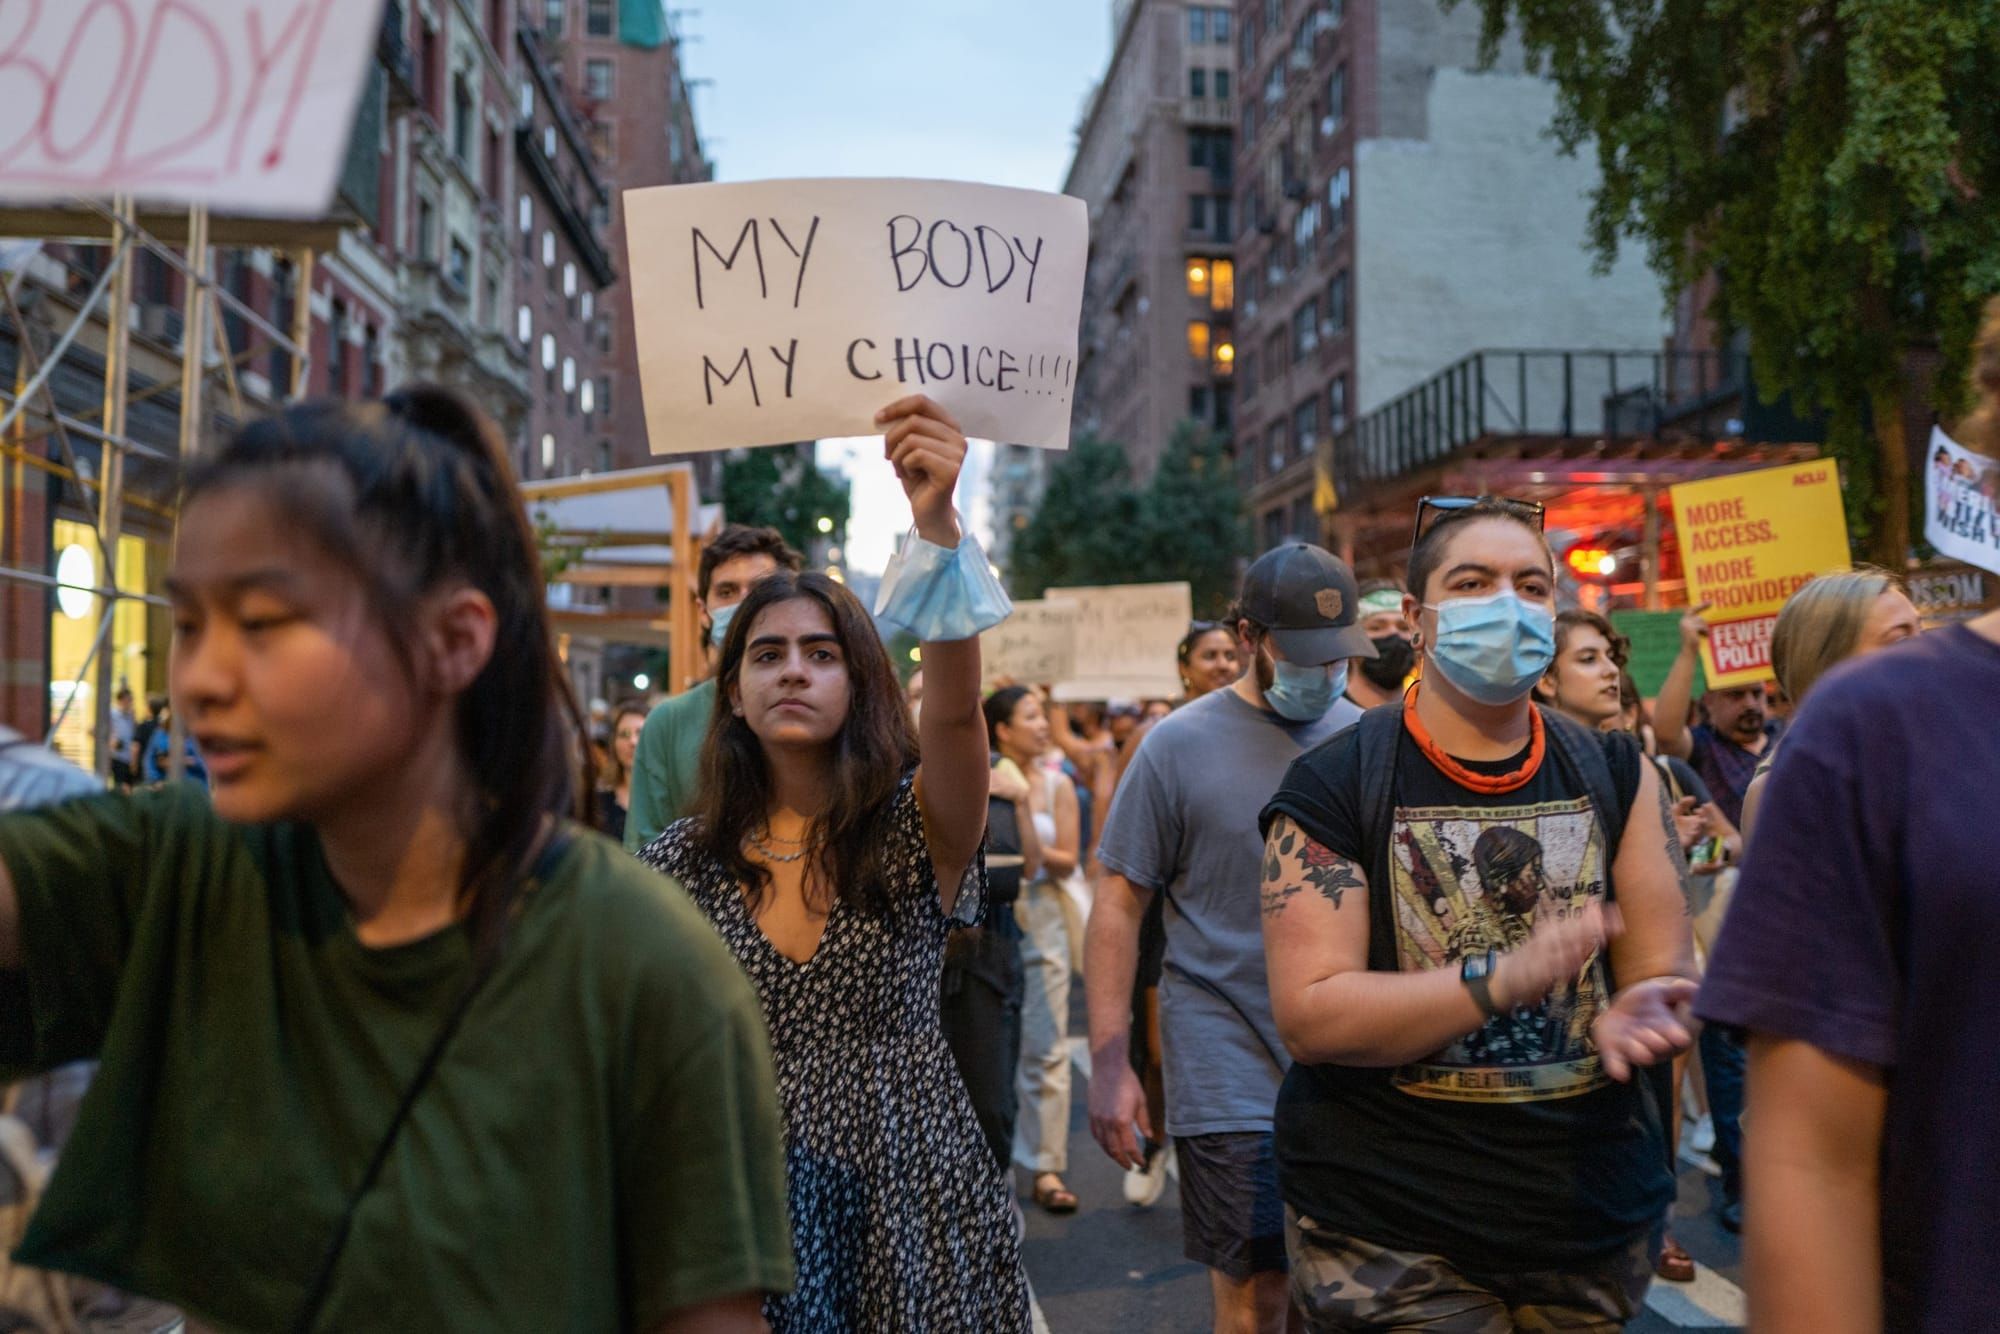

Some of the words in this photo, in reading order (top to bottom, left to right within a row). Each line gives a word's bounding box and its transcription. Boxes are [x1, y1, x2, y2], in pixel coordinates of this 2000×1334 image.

[692, 216, 820, 309] MY
[887, 214, 1043, 303] BODY
[702, 339, 798, 406] MY
[847, 337, 1072, 402] CHOICE!!!!
[1792, 471, 1827, 486] ACLU
[1686, 497, 1747, 528] MORE
[1690, 518, 1778, 552] ACCESS.
[1696, 556, 1756, 585] MORE
